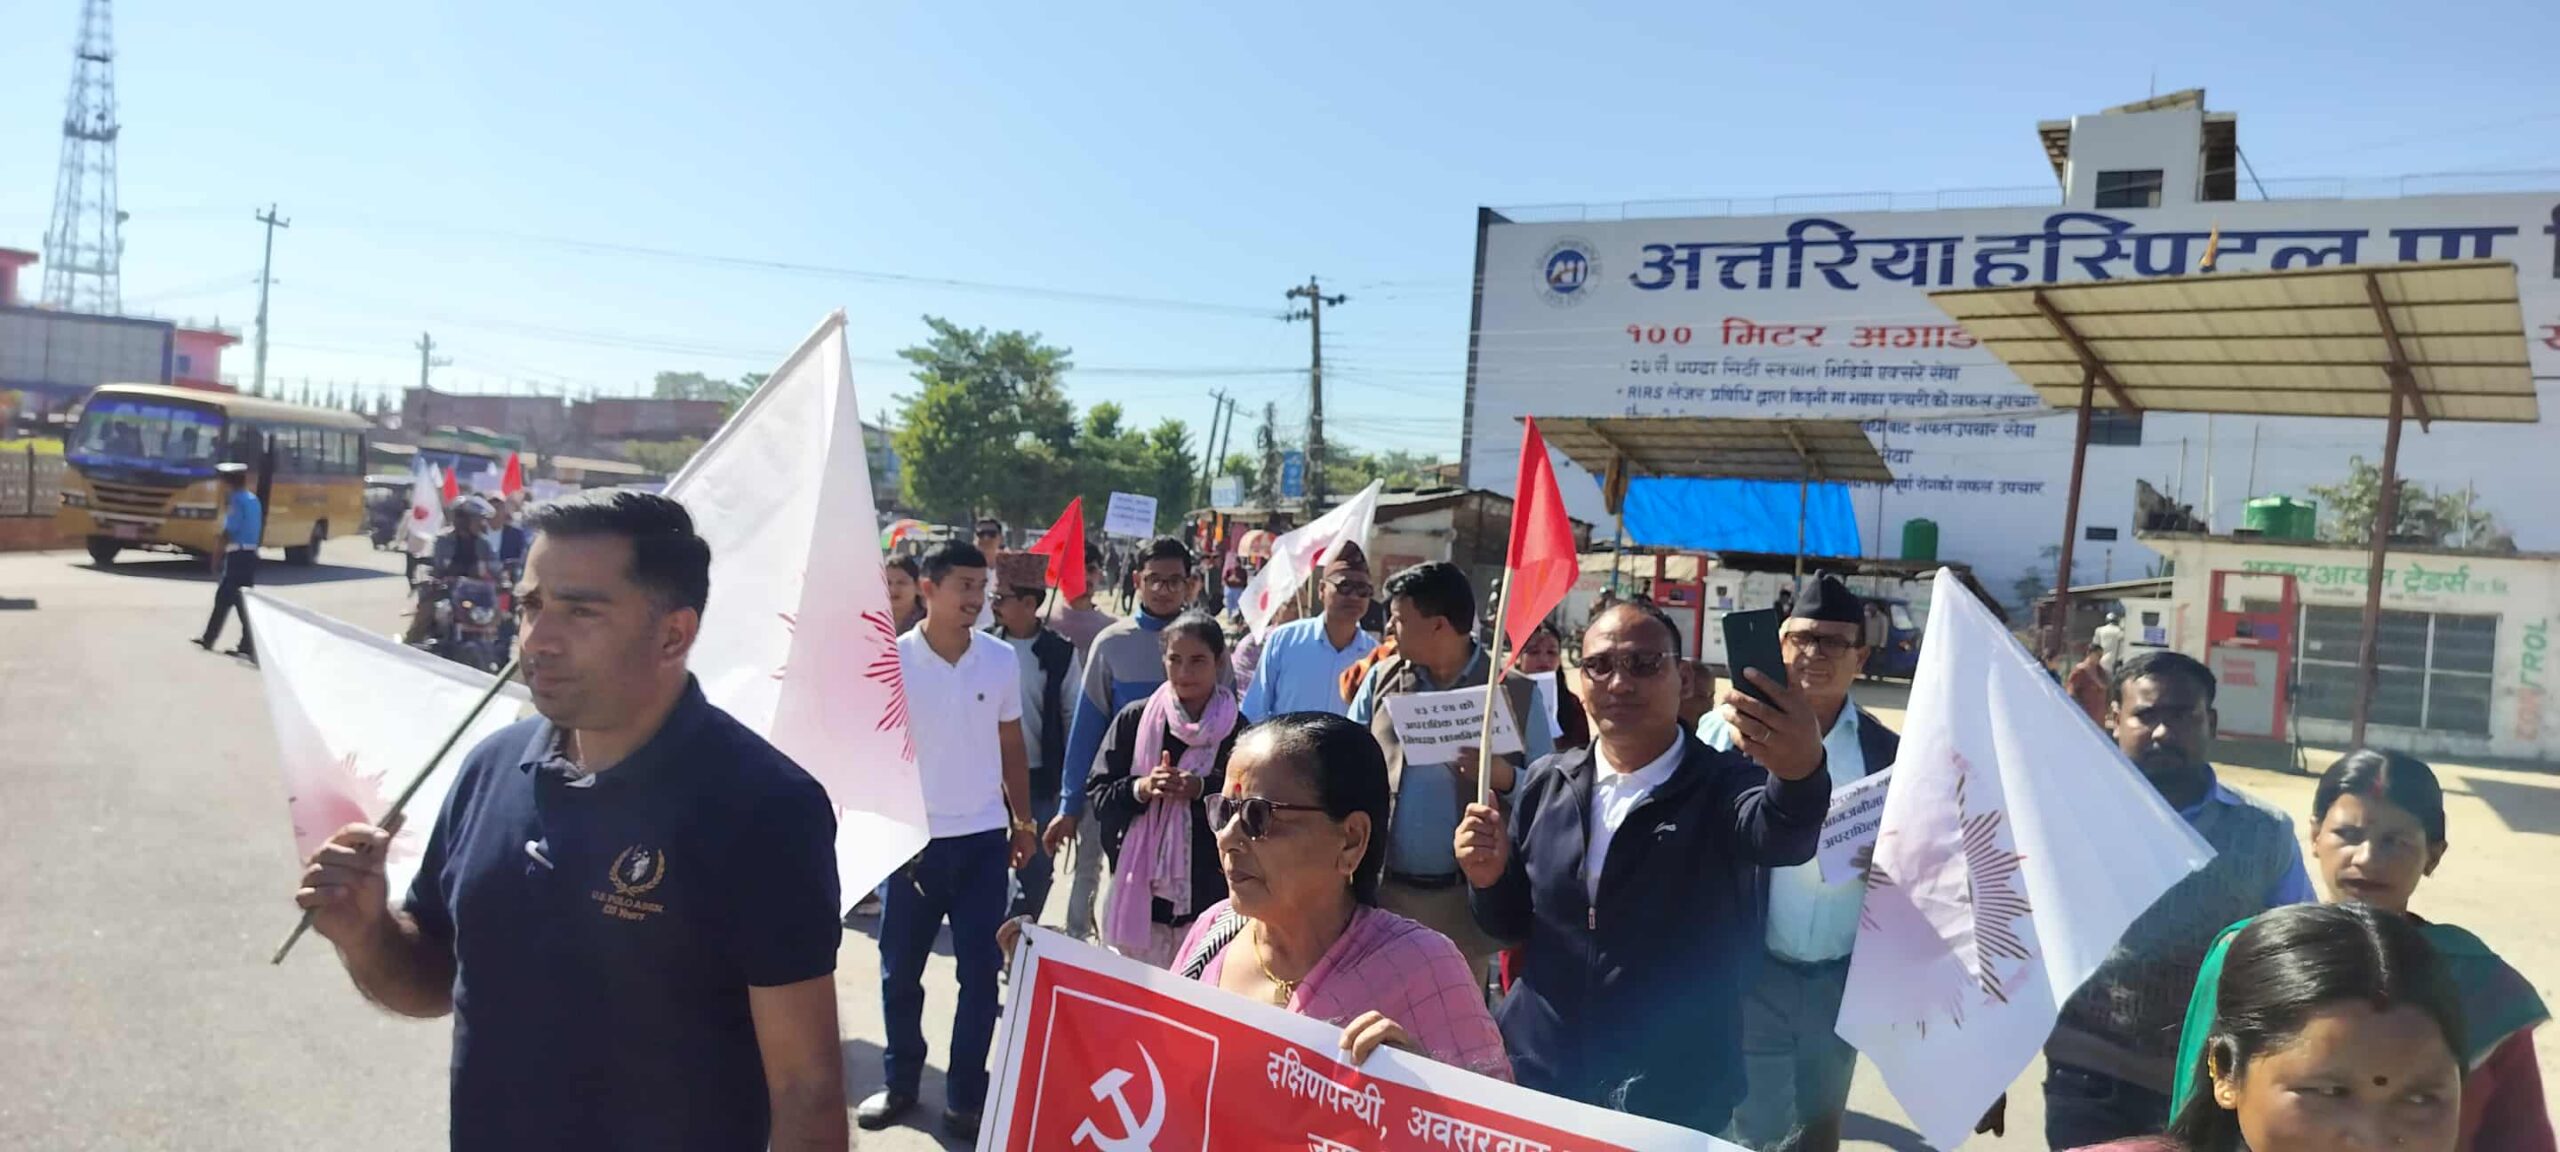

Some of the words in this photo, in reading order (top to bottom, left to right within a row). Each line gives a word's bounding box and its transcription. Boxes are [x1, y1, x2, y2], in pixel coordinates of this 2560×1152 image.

[1628, 217, 1964, 291] अत्तरिया
[1627, 323, 1692, 345] १००
[1721, 316, 1826, 348] मिटर
[1627, 385, 1663, 399] RIRS
